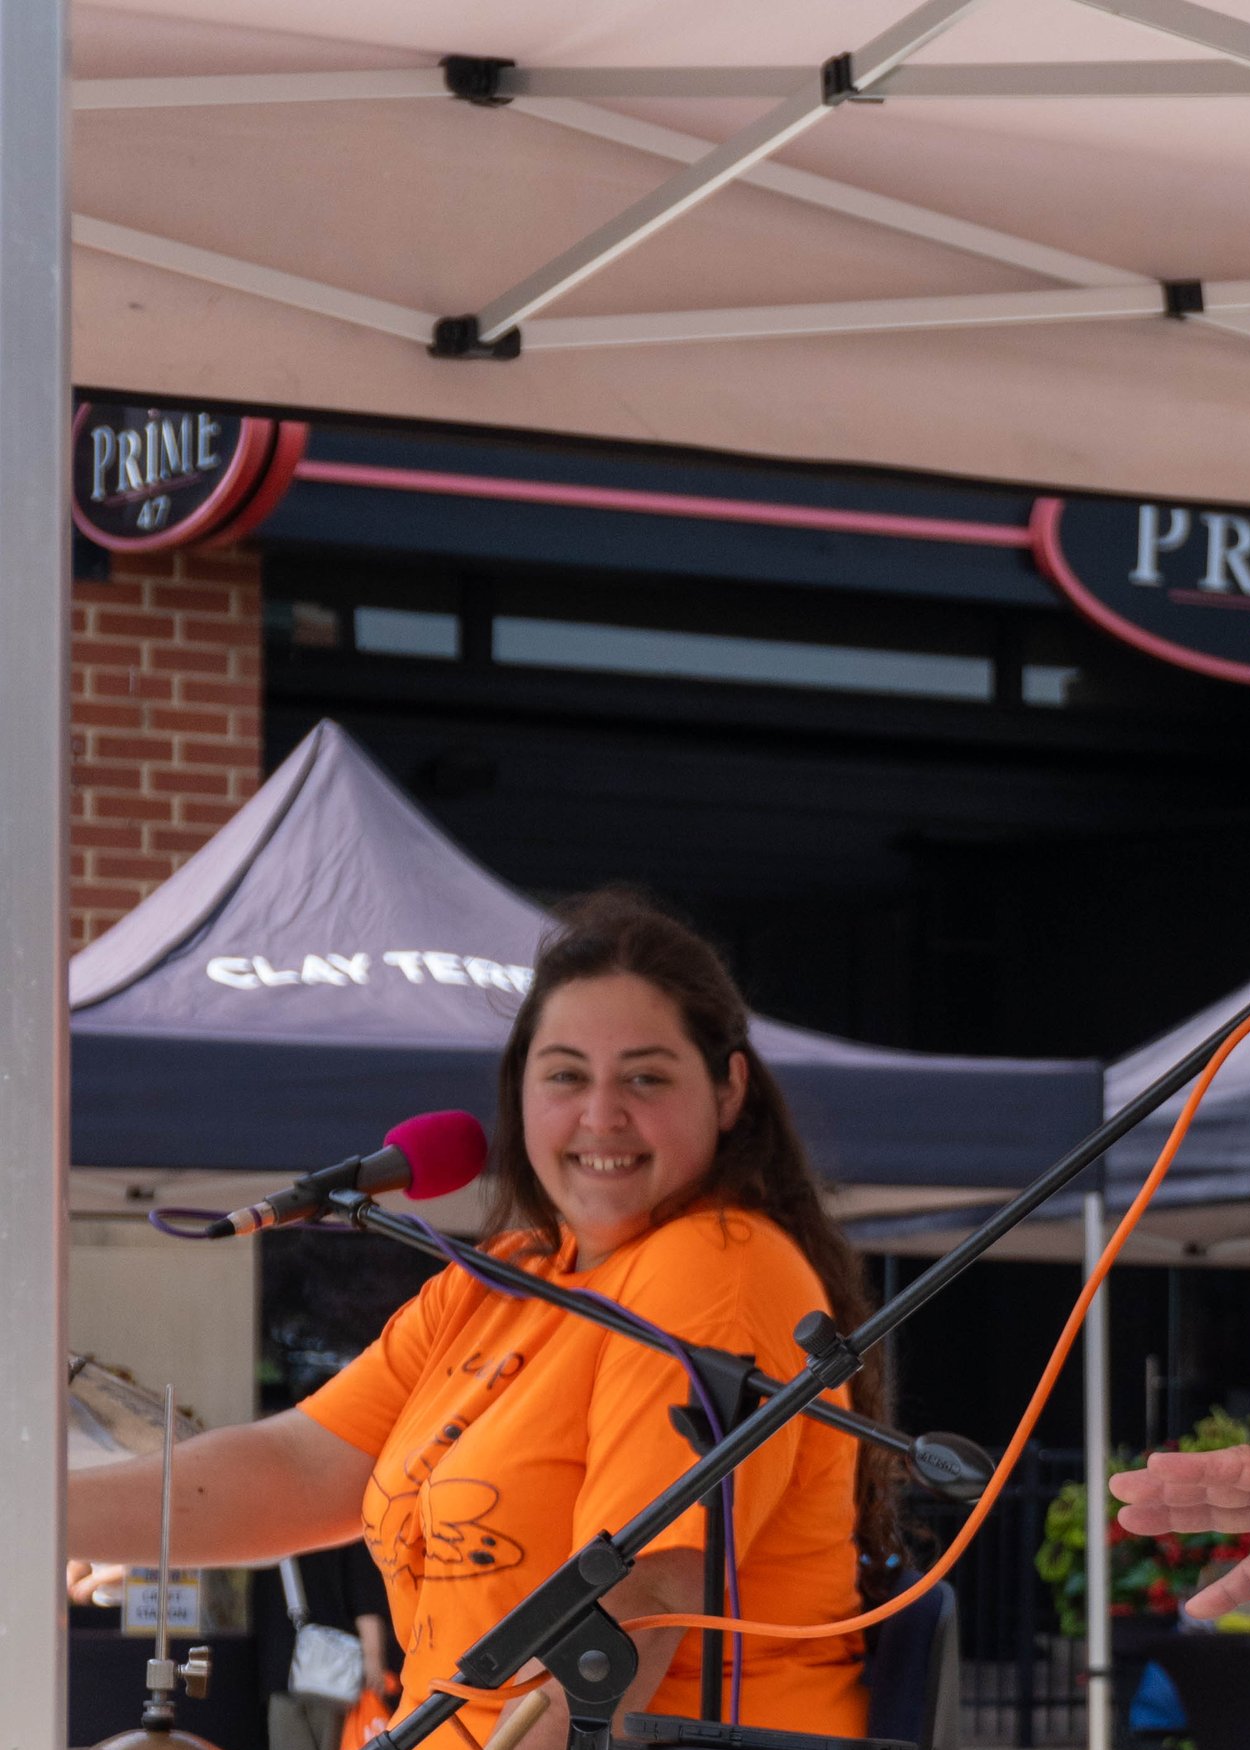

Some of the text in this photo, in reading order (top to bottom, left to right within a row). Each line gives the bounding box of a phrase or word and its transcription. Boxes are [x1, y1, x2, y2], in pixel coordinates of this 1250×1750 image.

[91, 412, 221, 501] PRIME
[136, 495, 172, 531] 47
[206, 950, 536, 995] CLAY TERR
